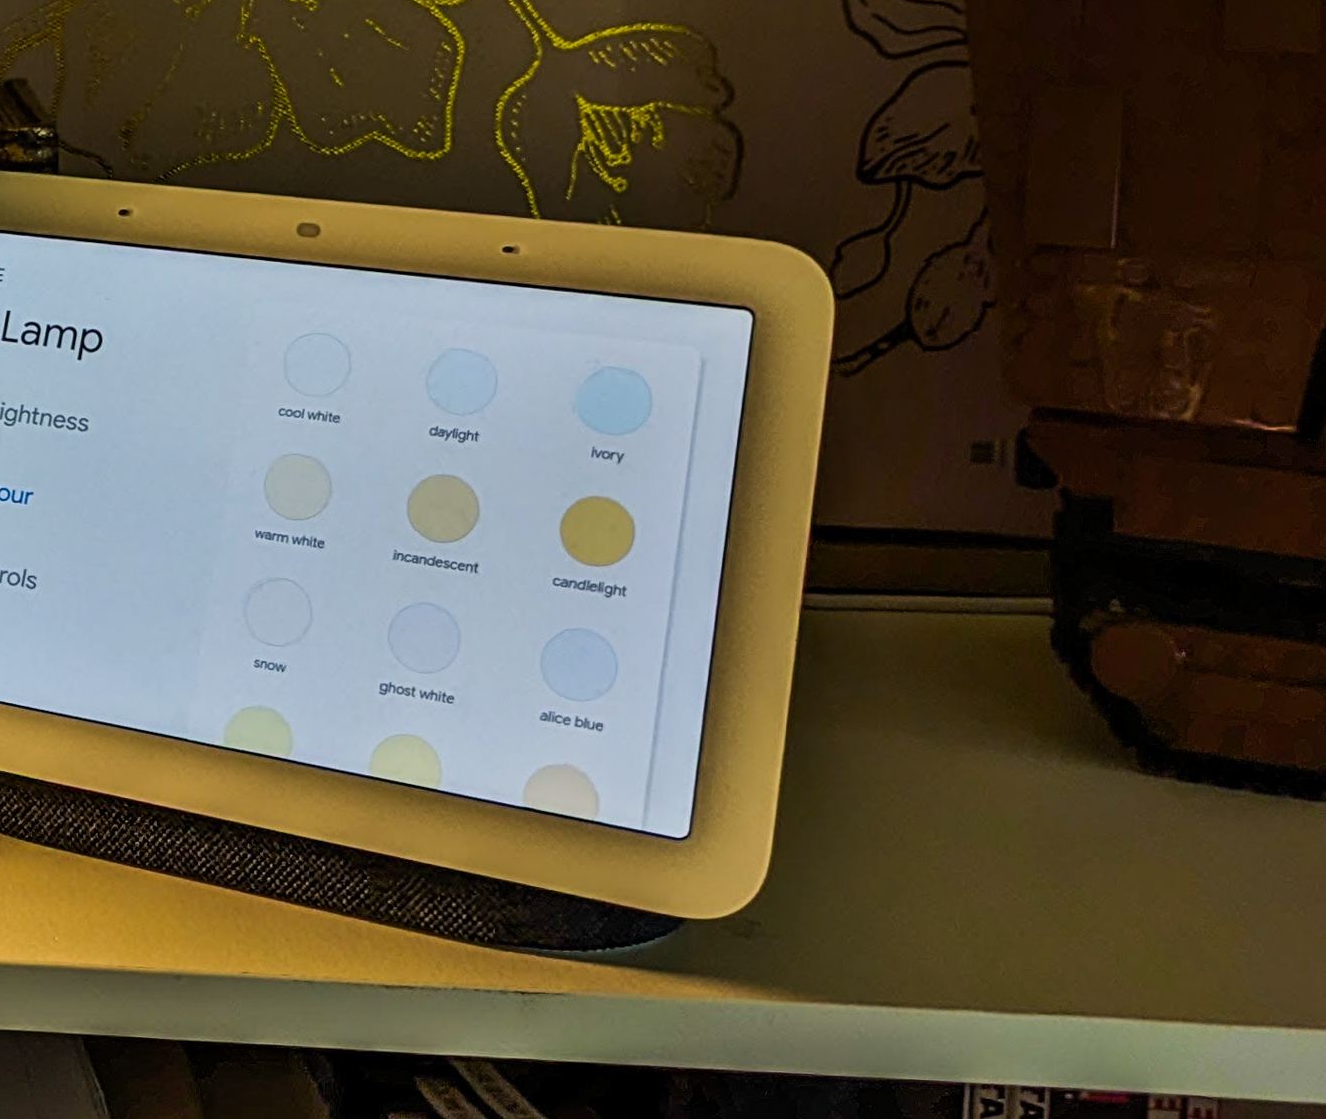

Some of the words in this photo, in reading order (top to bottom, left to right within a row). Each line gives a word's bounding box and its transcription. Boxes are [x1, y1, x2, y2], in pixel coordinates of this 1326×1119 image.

[1, 310, 104, 361] Lamp
[277, 405, 305, 420] cool
[307, 408, 341, 424] white
[428, 425, 481, 444] daylight
[589, 446, 626, 465] ivory
[254, 529, 290, 545] warm
[291, 534, 326, 550] white
[391, 549, 480, 575] incandescent
[551, 575, 629, 599] candlelight
[252, 657, 288, 674] snow
[378, 679, 416, 701] ghost
[416, 687, 456, 705] white
[539, 709, 572, 728] alice
[573, 715, 605, 732] blue
